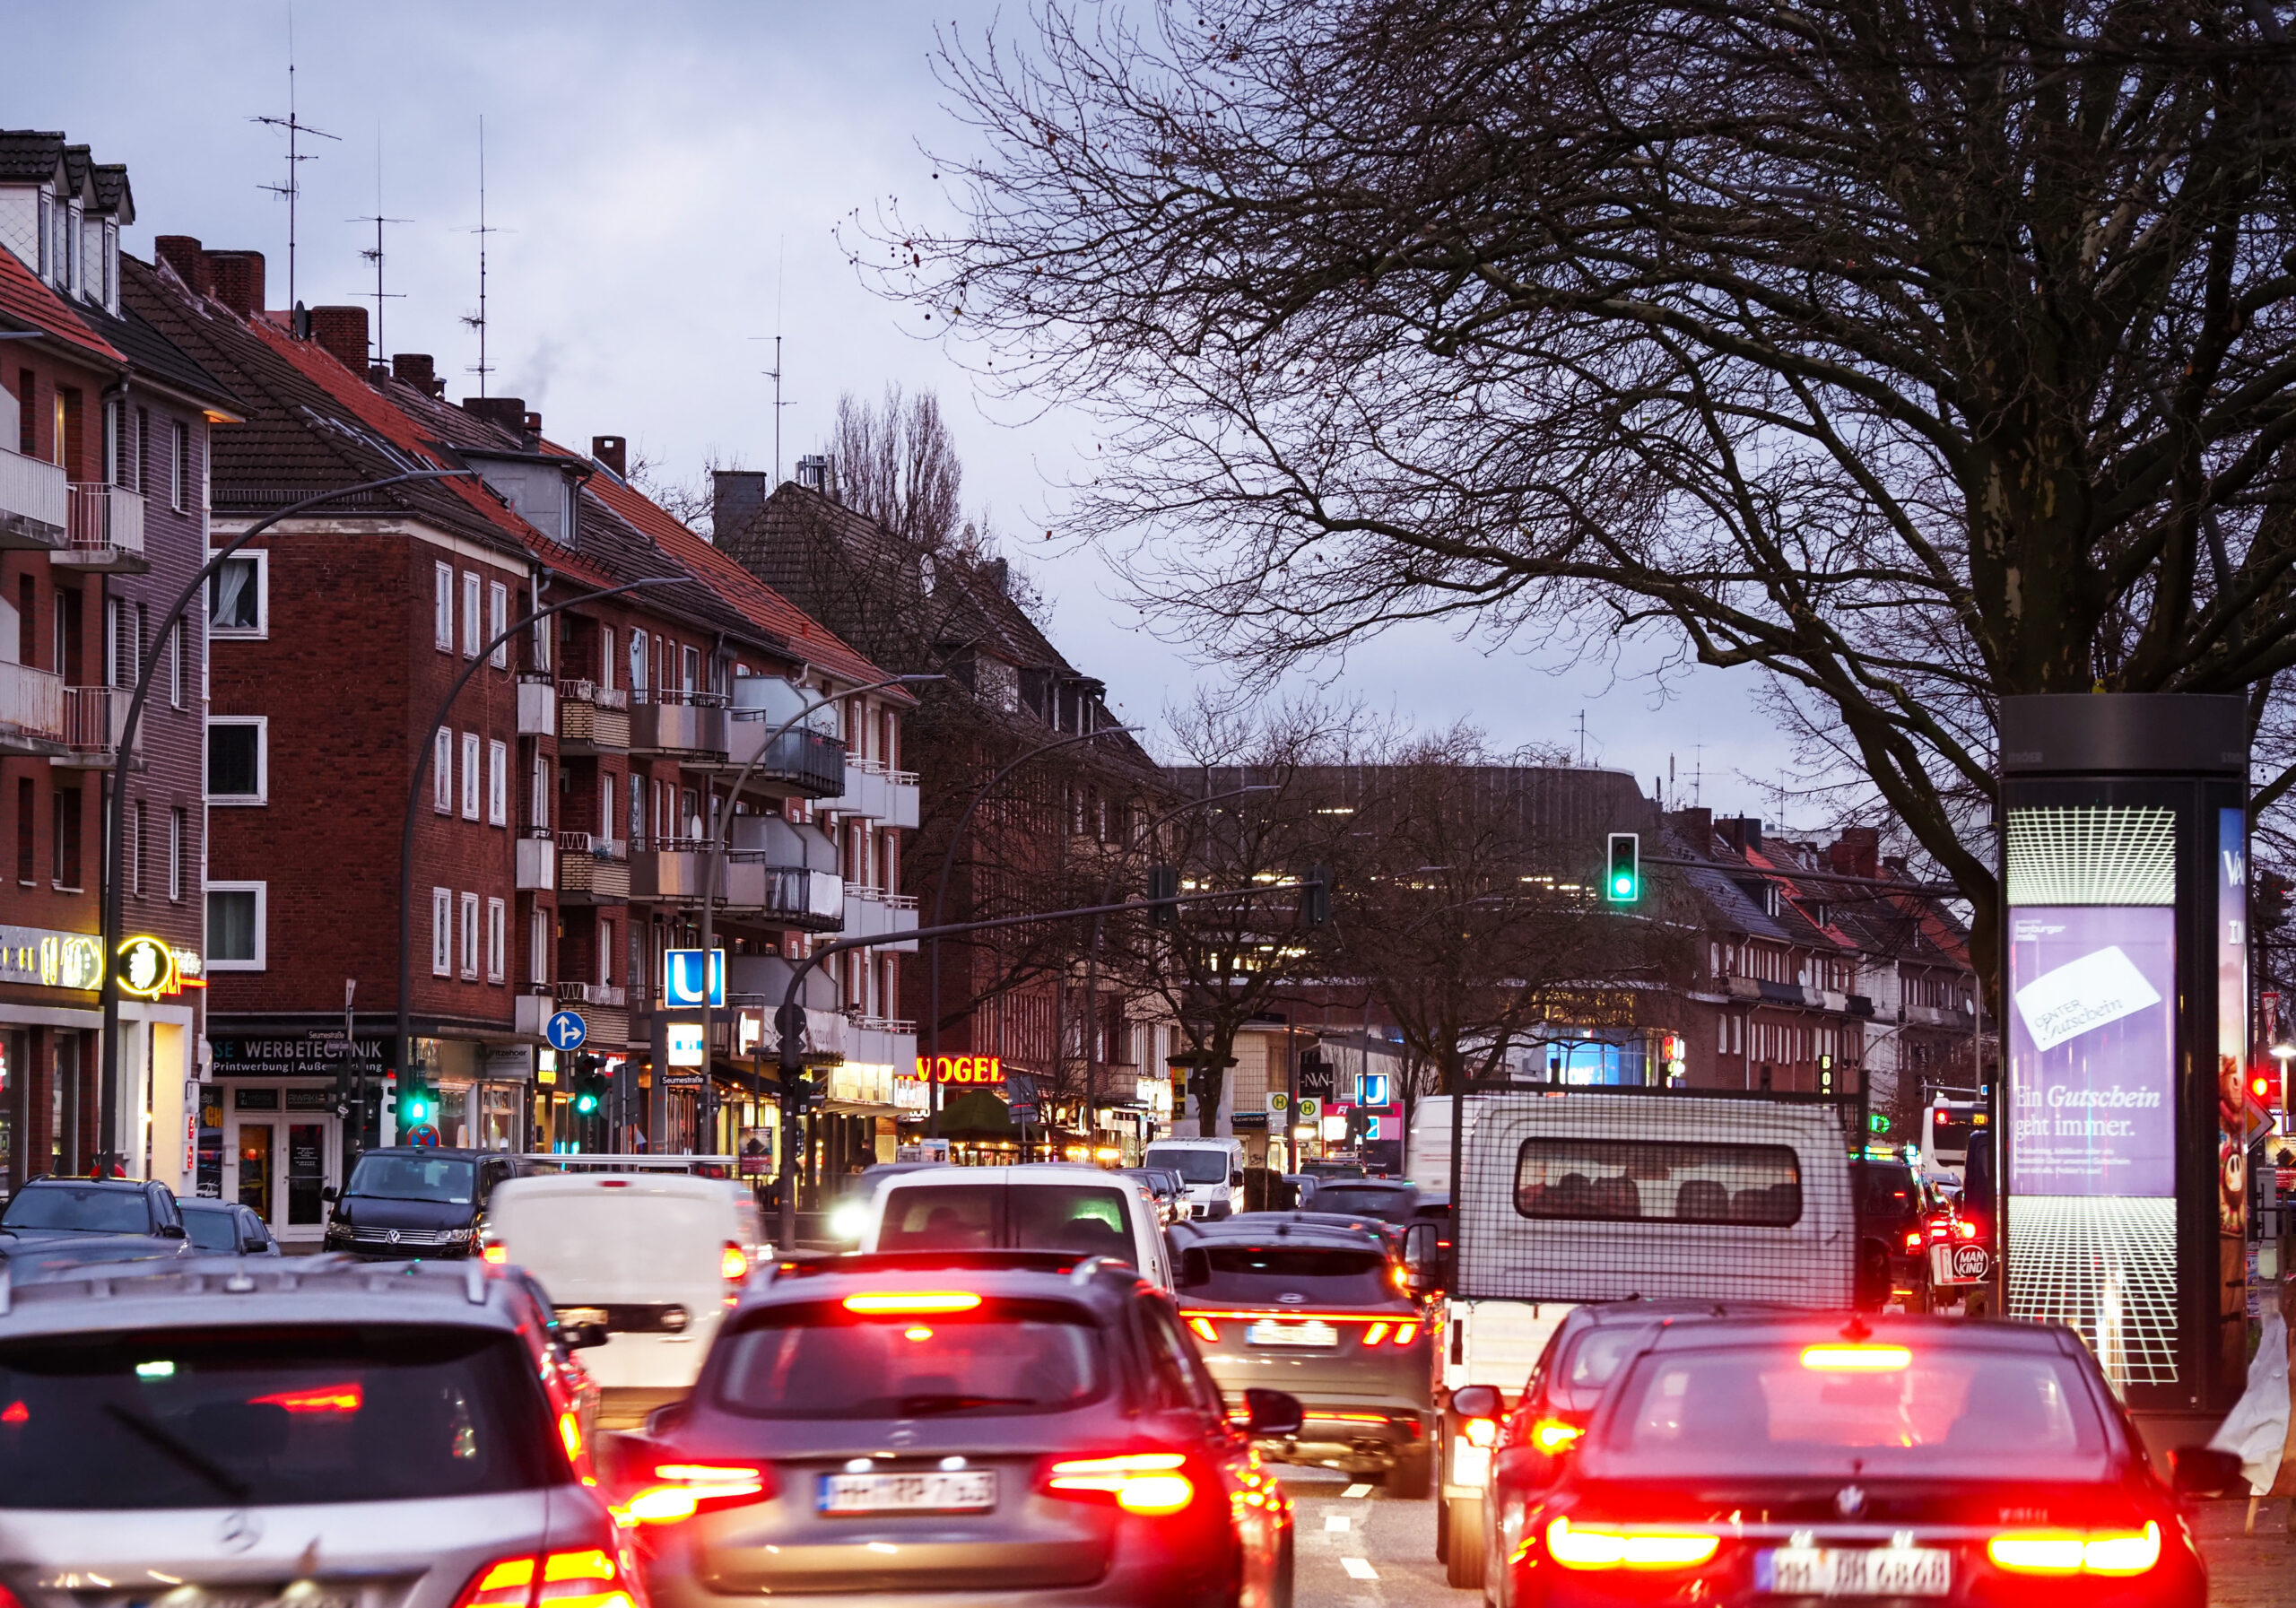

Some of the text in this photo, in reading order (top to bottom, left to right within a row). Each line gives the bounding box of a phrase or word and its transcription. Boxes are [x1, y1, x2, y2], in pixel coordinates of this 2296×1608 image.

[674, 953, 717, 1003] U
[2034, 998, 2082, 1029] CENTER
[213, 1062, 289, 1073] Printwerbung
[916, 1056, 1004, 1082] VOGEL
[662, 1076, 704, 1084] Seumestraße
[2016, 1085, 2161, 1108] Ein Gutschein
[2016, 1114, 2135, 1141] geht immer.
[1959, 1262, 1983, 1273] KIND
[1960, 1251, 1984, 1263] MAN
